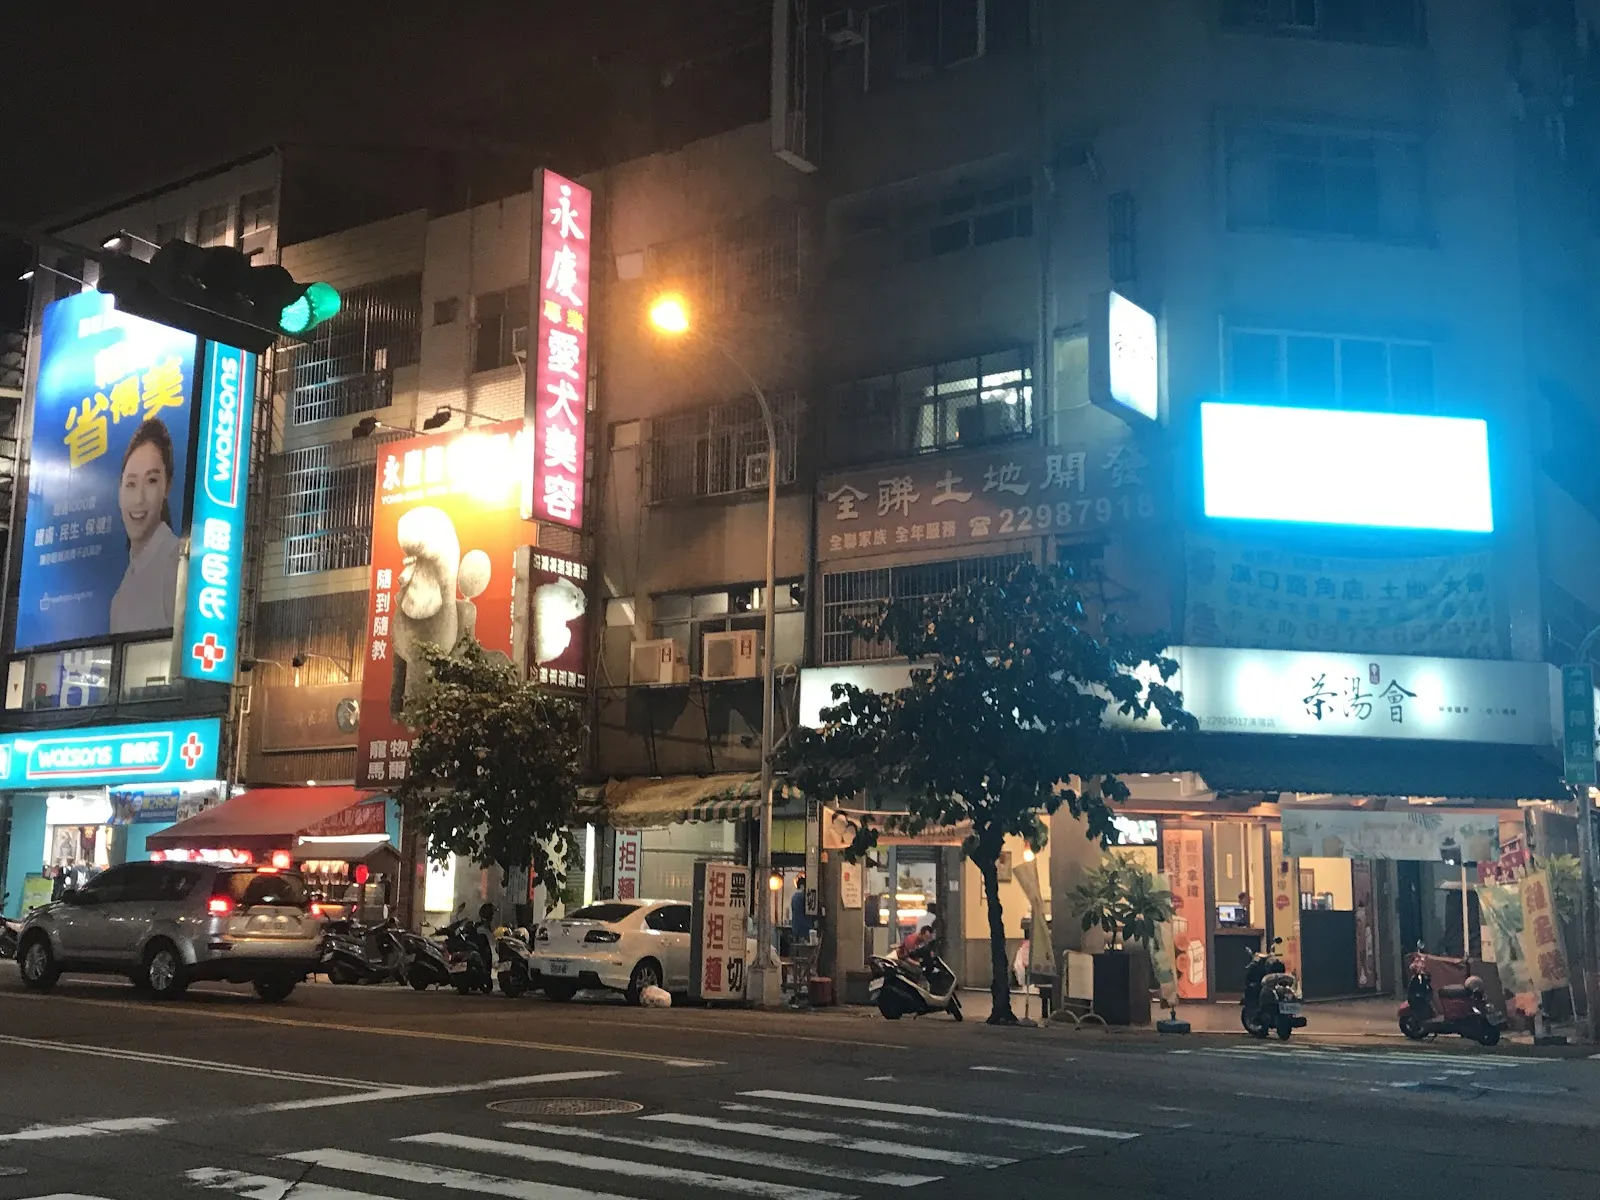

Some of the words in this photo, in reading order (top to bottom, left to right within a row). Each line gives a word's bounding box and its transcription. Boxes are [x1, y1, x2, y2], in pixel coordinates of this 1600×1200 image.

[213, 356, 238, 482] watsons
[543, 328, 580, 521] 愛犬美容
[199, 517, 231, 621] 屈臣氏
[371, 568, 392, 661] 隨到隨教
[1303, 673, 1417, 723] 茶湯會
[38, 745, 112, 768] watsons
[367, 760, 414, 780] 馬爾
[617, 830, 638, 900] 担麵
